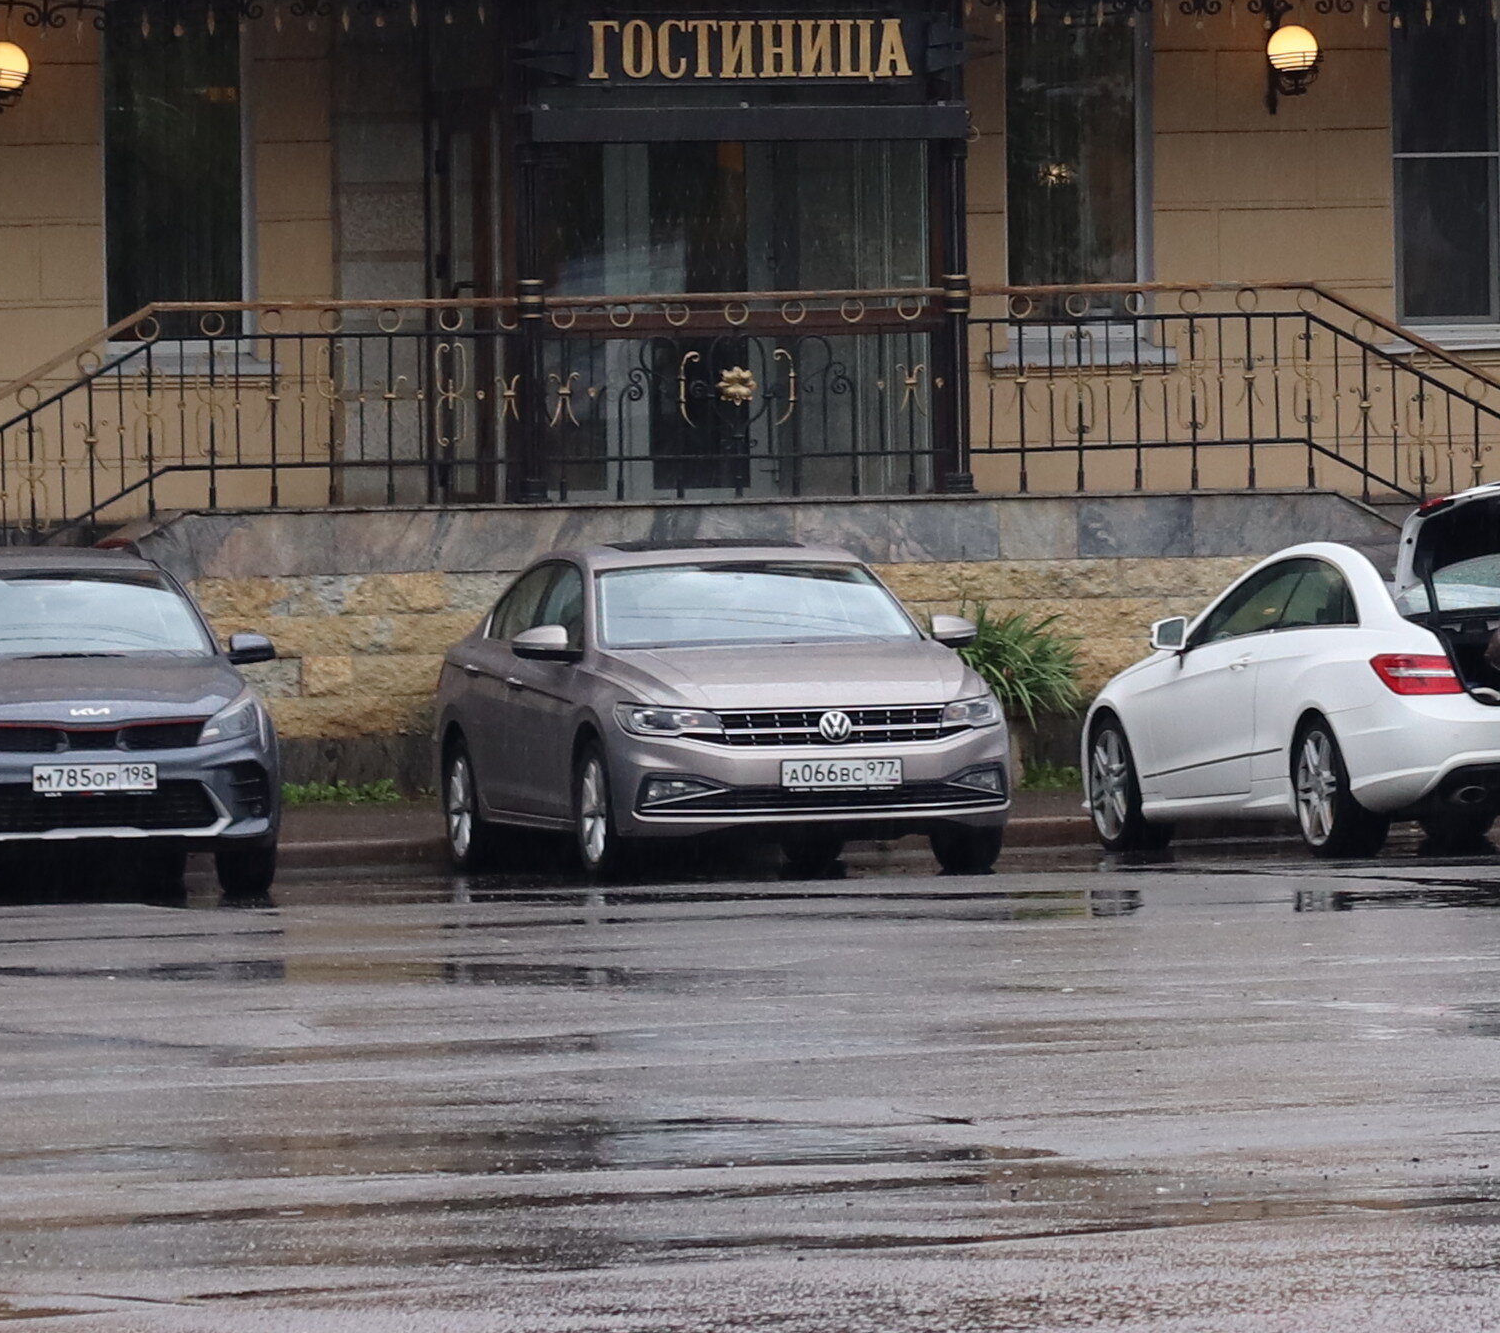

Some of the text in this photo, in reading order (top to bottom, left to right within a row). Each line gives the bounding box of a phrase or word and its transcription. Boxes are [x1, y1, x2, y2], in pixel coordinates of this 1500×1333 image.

[588, 19, 913, 82] ГОСТИНИЦА
[37, 766, 152, 788] М785ОР 198
[789, 761, 896, 783] А066ВС 977
